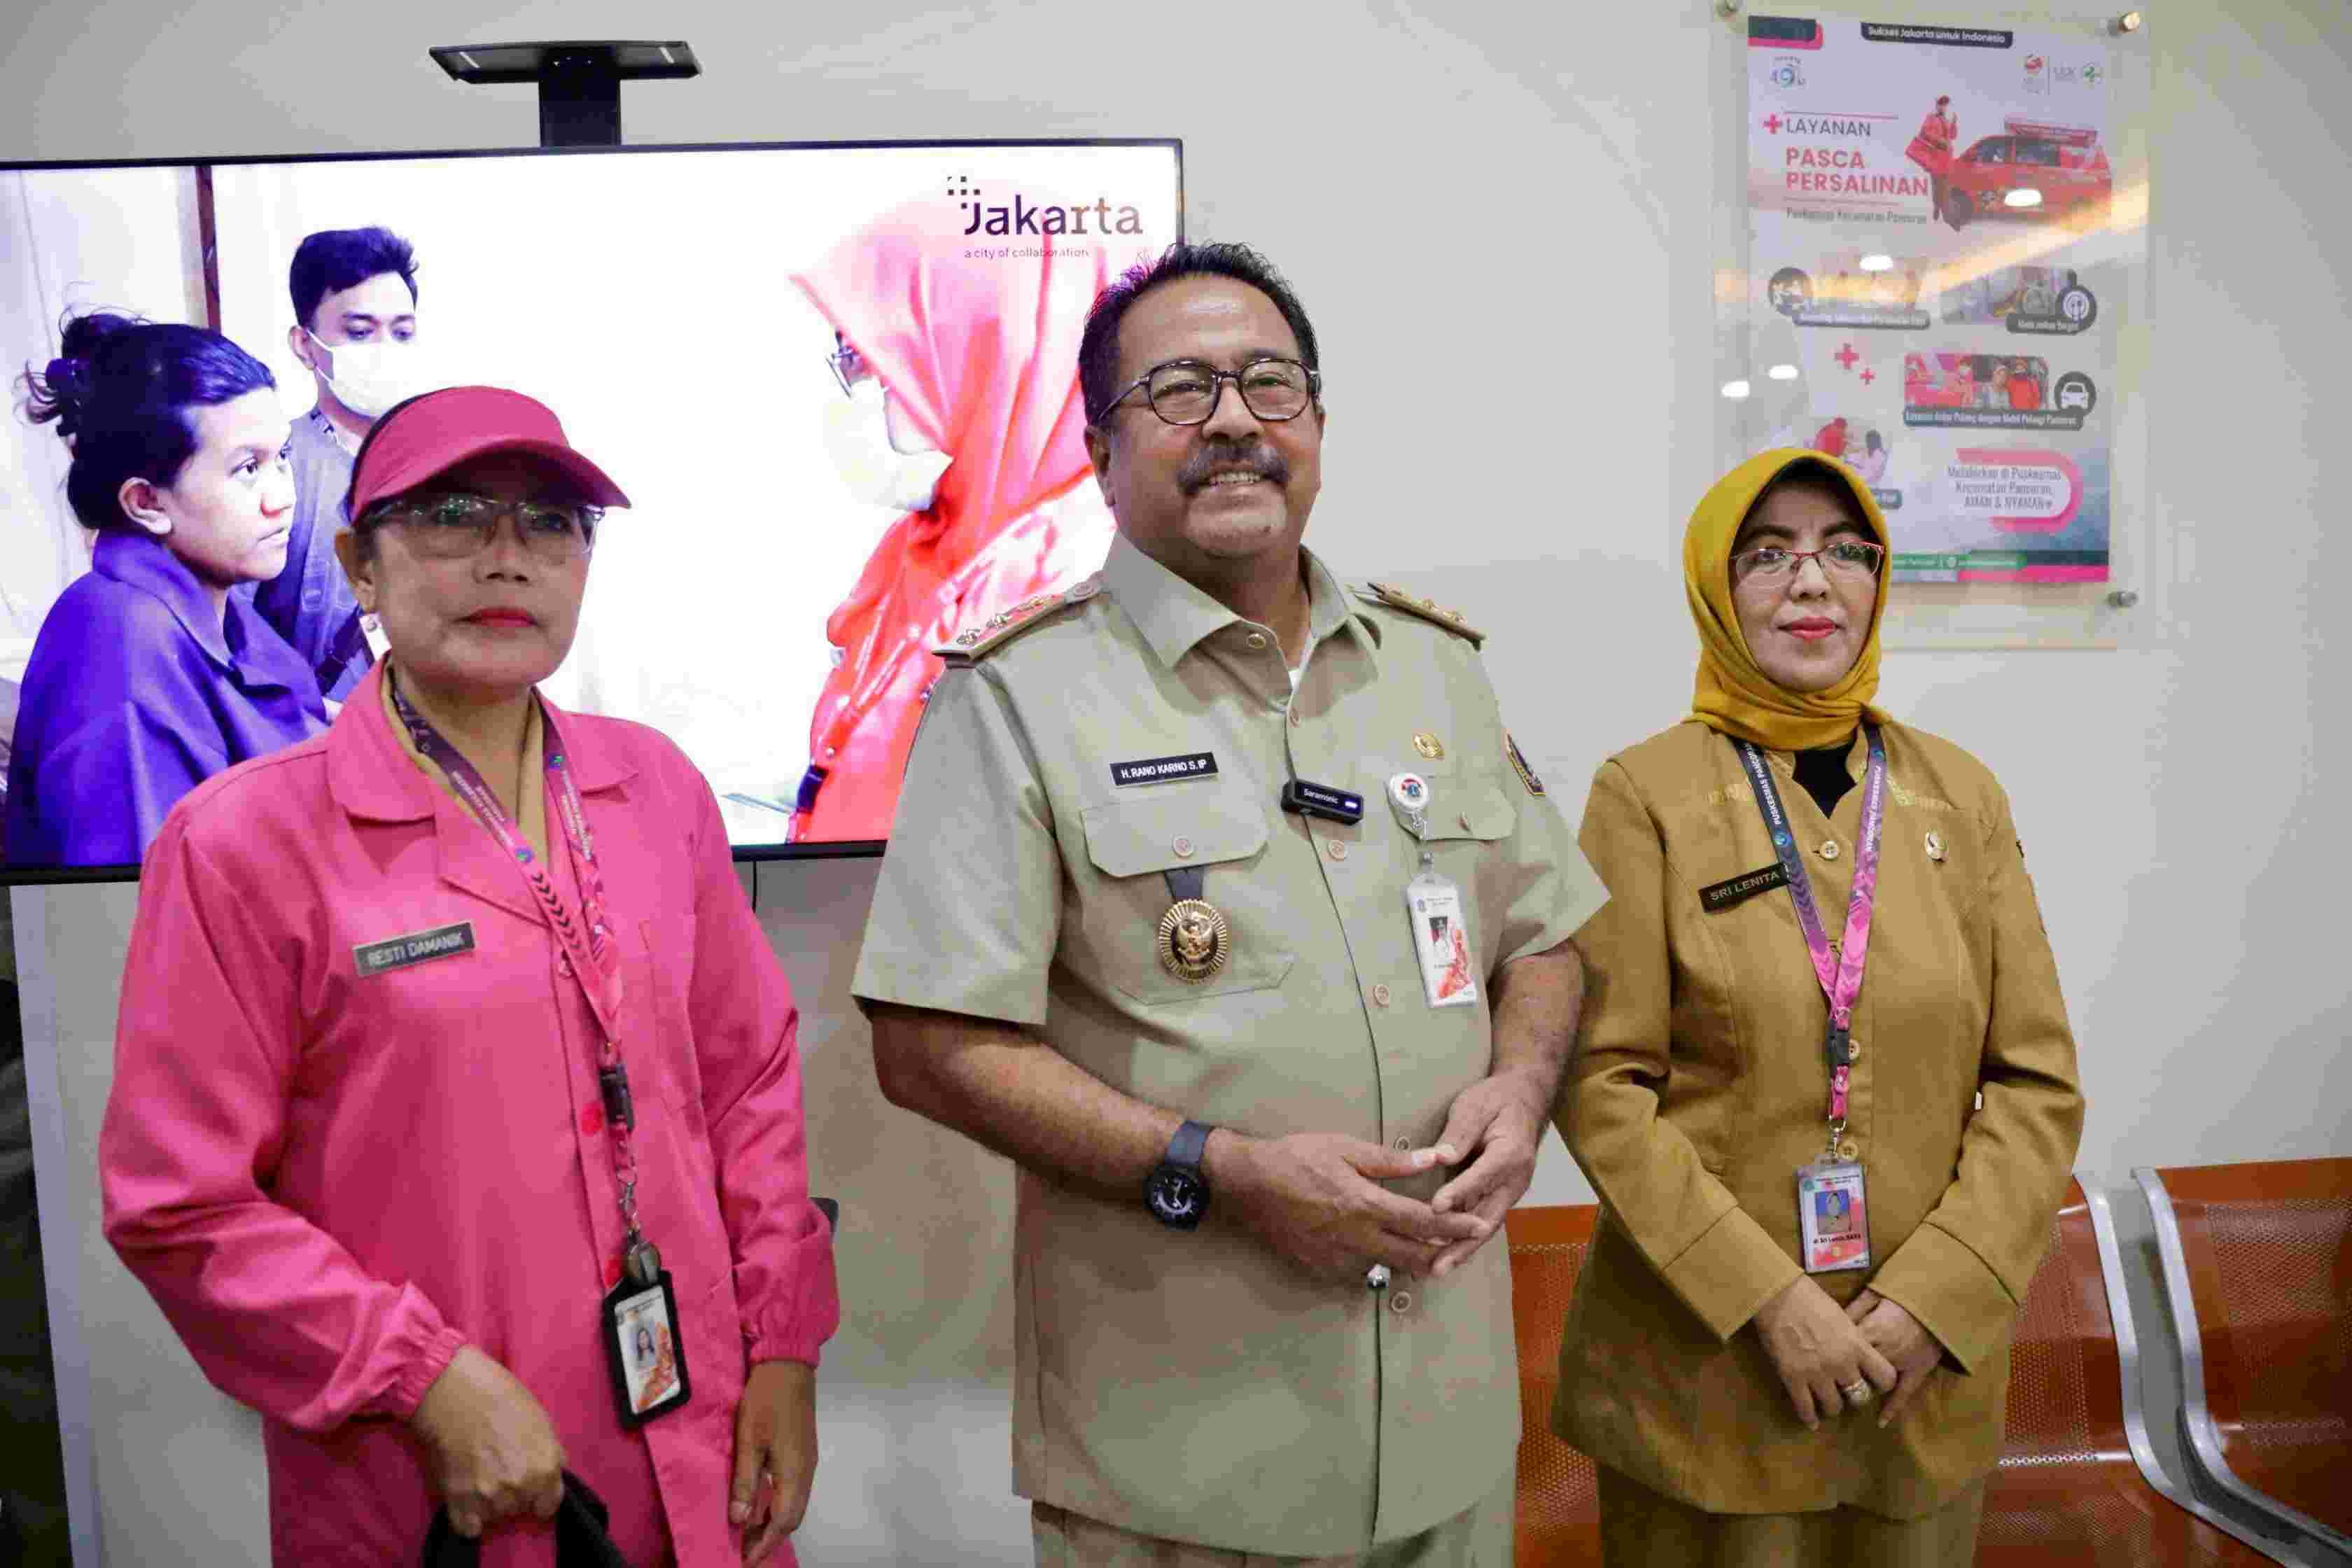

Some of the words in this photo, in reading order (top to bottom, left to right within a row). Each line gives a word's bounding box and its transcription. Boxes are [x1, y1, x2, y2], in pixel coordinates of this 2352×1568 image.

[1901, 27, 1934, 39] Jakarta
[1936, 30, 1960, 40] untuk
[1962, 32, 2005, 43] Indonesia
[1786, 118, 1871, 136] LAYANAN
[1786, 147, 1865, 169] PASCA
[1786, 172, 1928, 196] PERSALINAN
[964, 250, 971, 258] a
[974, 246, 994, 260] city
[997, 246, 1009, 258] of
[1012, 246, 1091, 258] collaboration
[1157, 762, 1187, 774] KARNO
[1304, 788, 1338, 804] Saramonic
[1709, 887, 1731, 901] SRI
[1735, 871, 1780, 892] LENITA
